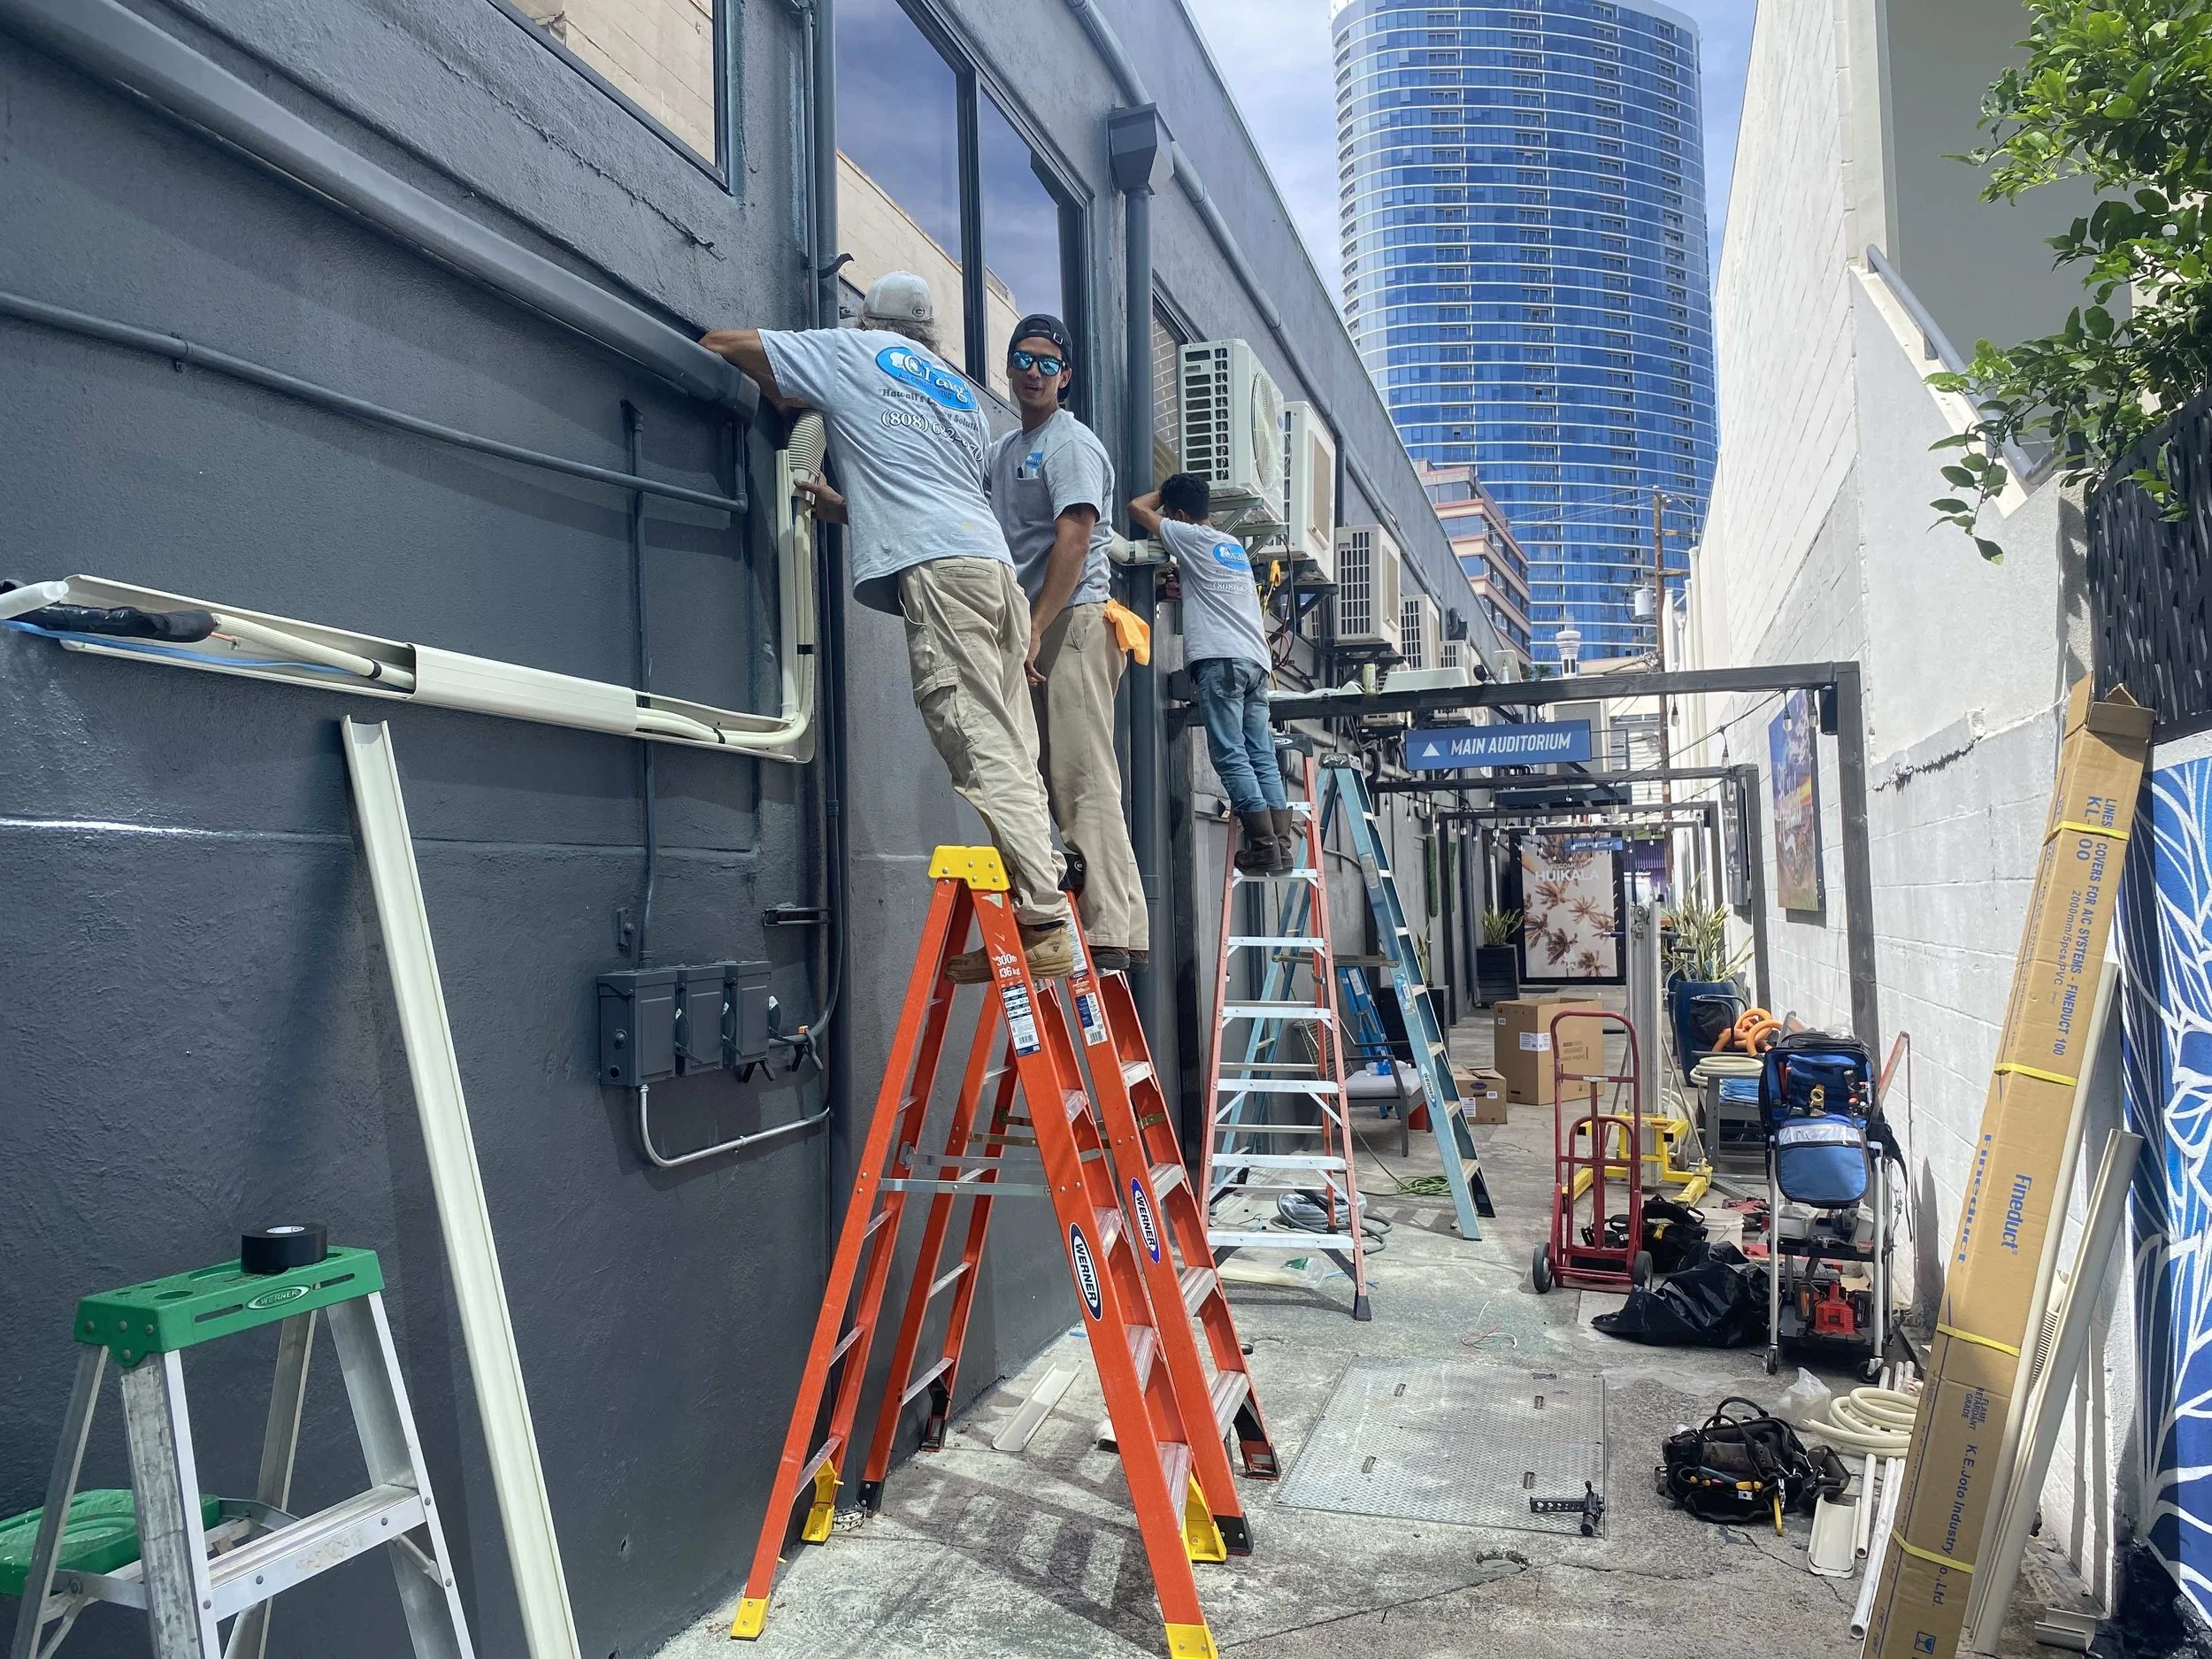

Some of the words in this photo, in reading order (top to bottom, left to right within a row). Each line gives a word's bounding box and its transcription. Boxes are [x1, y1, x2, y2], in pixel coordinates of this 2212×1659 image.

[881, 410, 929, 433] (808)
[1450, 738, 1486, 757] MAIN
[1487, 733, 1571, 754] AUDITORIUM
[2077, 796, 2102, 861] KL-00
[2101, 798, 2117, 837] LINES
[1535, 869, 1601, 882] HUIKALA
[2090, 842, 2108, 882] COVERS
[2085, 885, 2100, 906] FOR
[2081, 908, 2094, 926] A/C
[2070, 928, 2090, 974] SYSTEMS
[998, 966, 1013, 979] 136
[2057, 984, 2078, 1034] FINEDUCT
[2053, 1038, 2067, 1056] 100
[1135, 1195, 1156, 1248] WERNER
[1074, 1242, 1097, 1302] WERNER
[259, 1289, 298, 1305] WERNER
[1962, 1393, 1973, 1420] GRADE
[1969, 1386, 1984, 1431] RETARDANT
[1978, 1398, 1990, 1424] FLAME
[1941, 1501, 1965, 1555] Industry
[1932, 1563, 1948, 1606] o.,Ltd.
